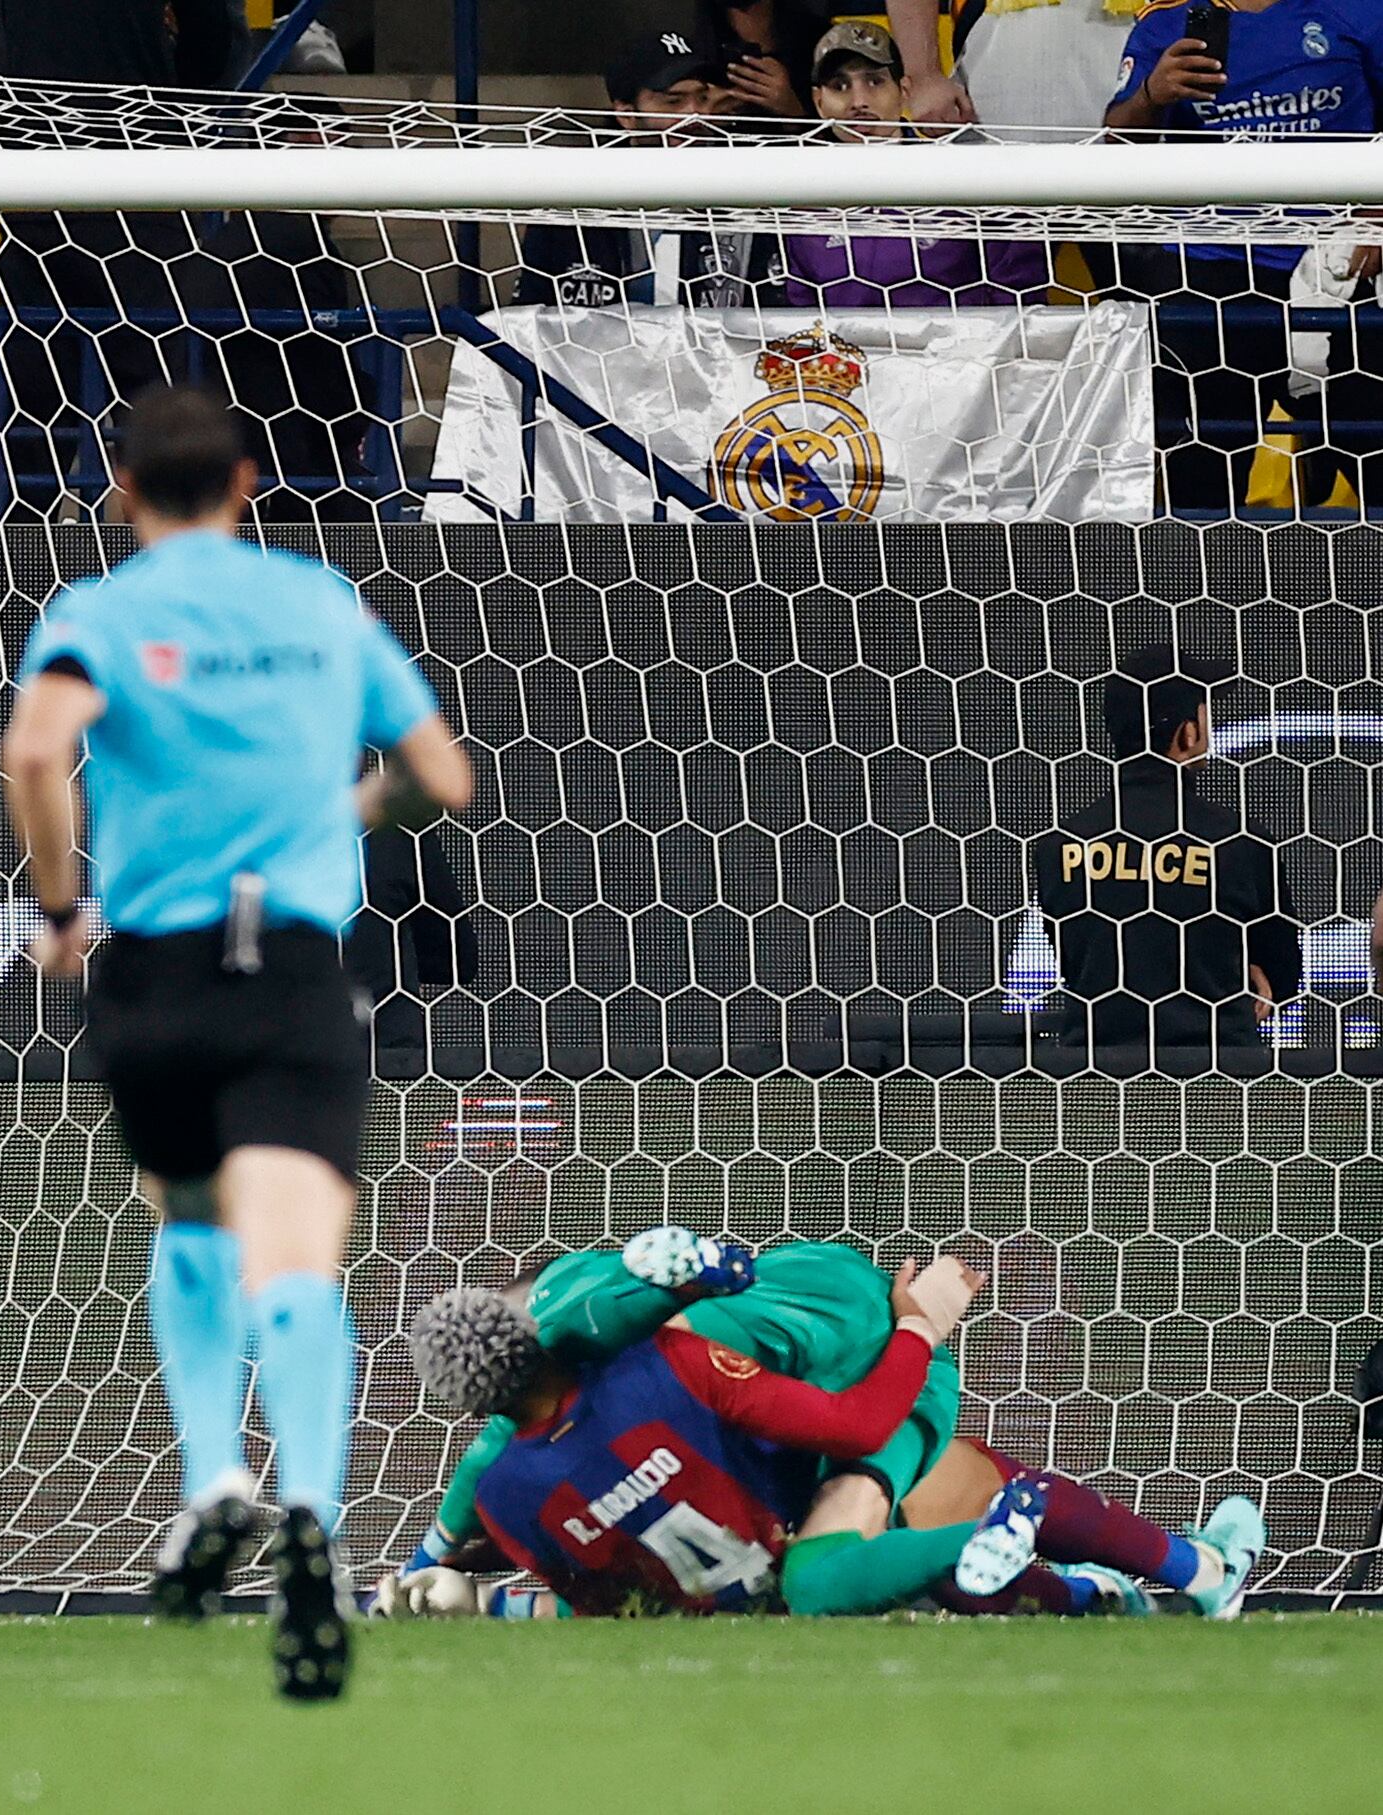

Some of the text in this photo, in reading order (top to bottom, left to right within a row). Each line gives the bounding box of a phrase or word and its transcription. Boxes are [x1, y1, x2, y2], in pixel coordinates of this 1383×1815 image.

[1192, 86, 1343, 124] Emirates
[1062, 842, 1212, 886] POLICE
[638, 1500, 774, 1596] 4
